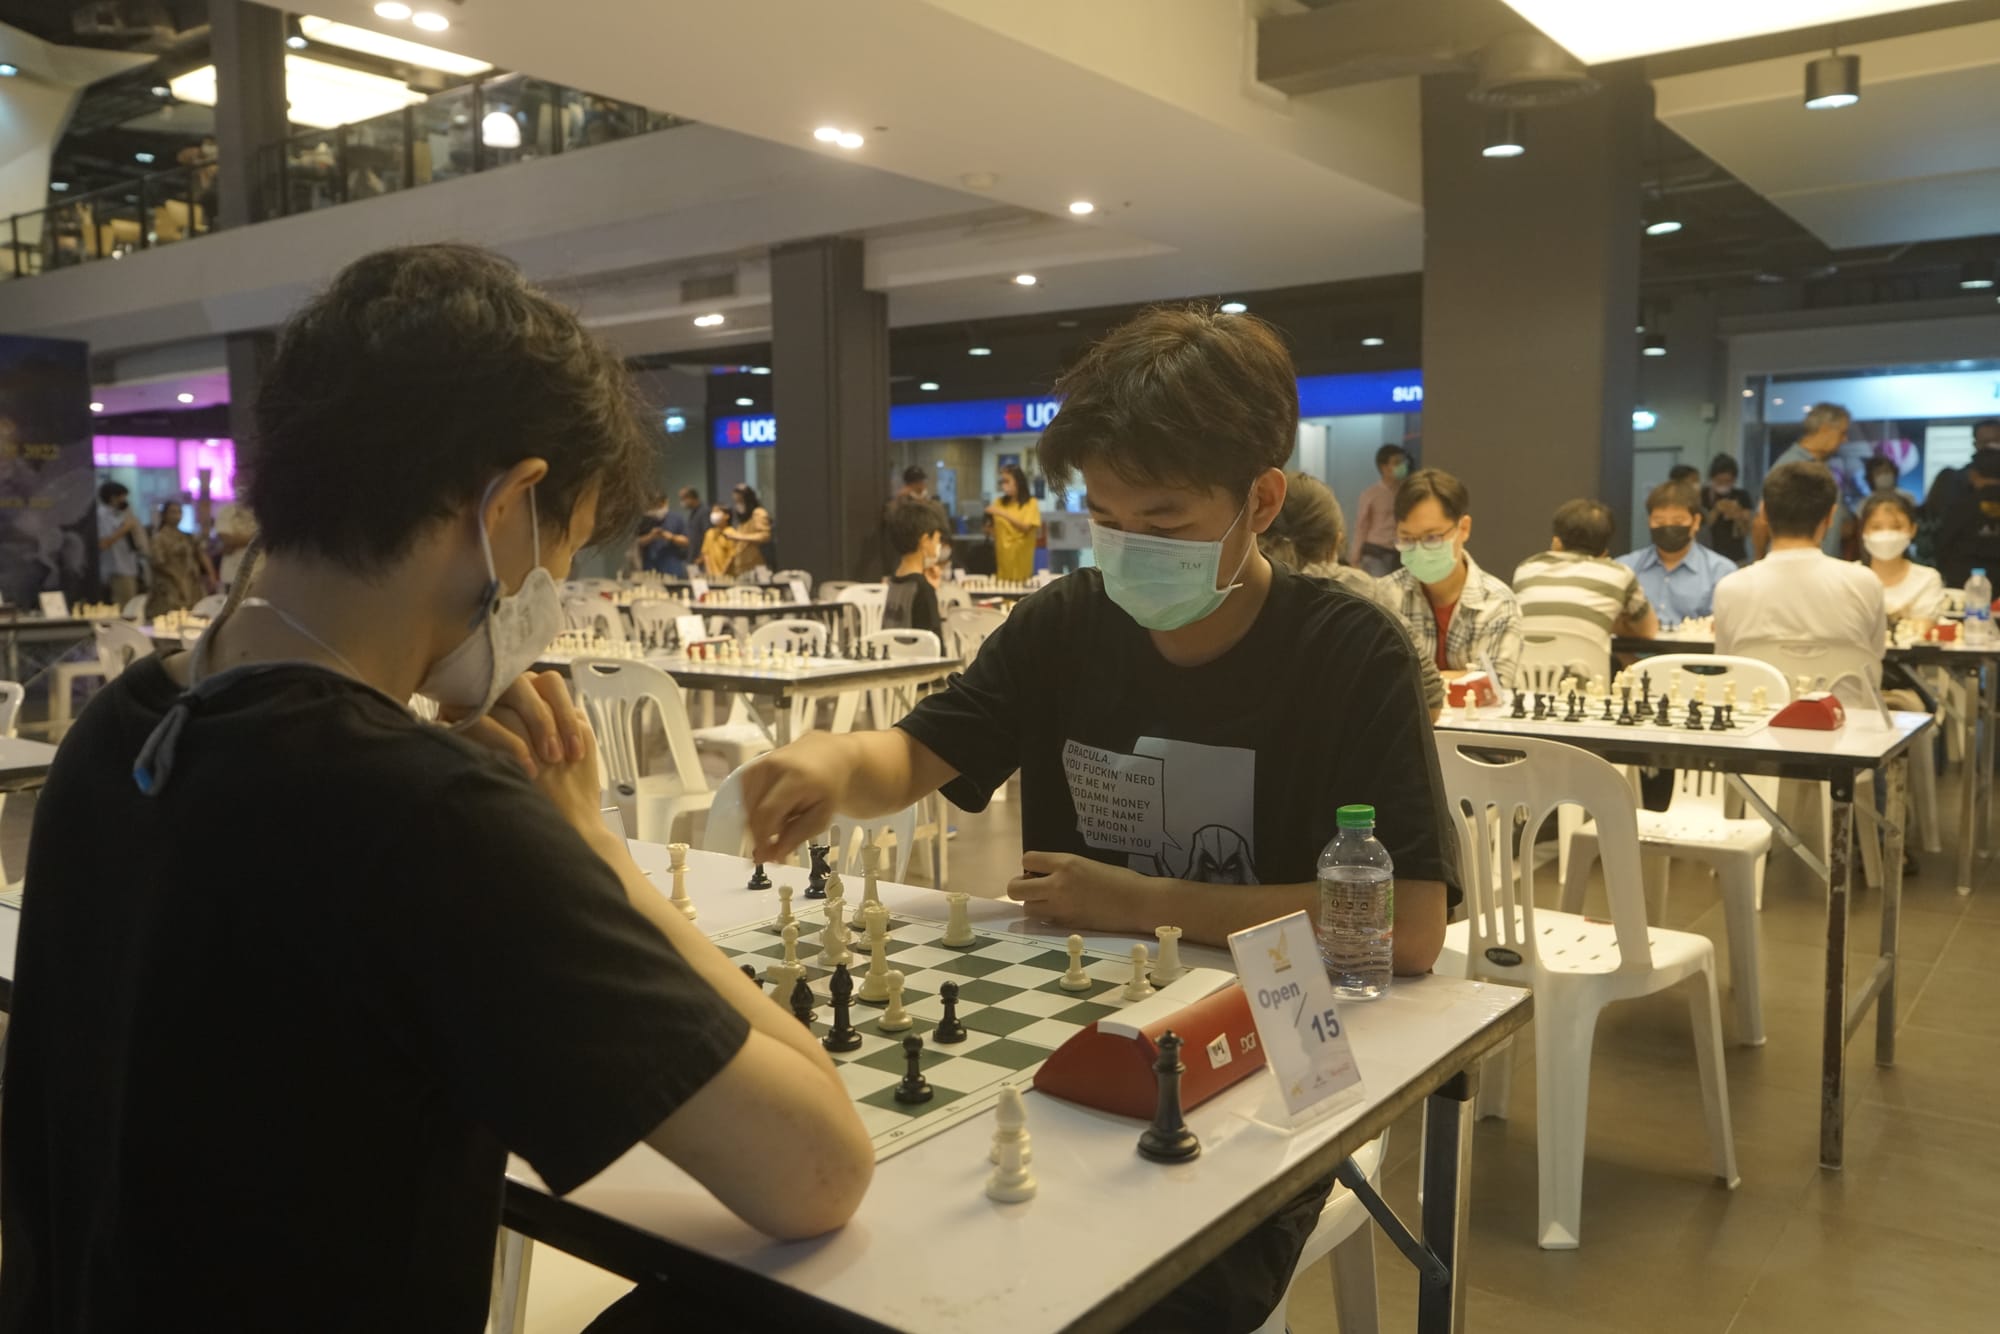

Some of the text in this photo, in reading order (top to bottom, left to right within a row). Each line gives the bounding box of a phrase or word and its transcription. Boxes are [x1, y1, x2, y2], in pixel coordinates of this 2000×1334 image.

[1026, 402, 1061, 428] UO
[1065, 757, 1081, 770] YOU
[1125, 773, 1156, 786] NERD
[1085, 777, 1100, 788] ME
[1102, 781, 1116, 792] MY
[1077, 802, 1145, 822] IN THE NAME
[1112, 797, 1151, 810] MONEY
[1080, 815, 1094, 827] HE
[1097, 819, 1128, 833] MOON
[1086, 830, 1152, 849] PUNISH YOU
[1258, 982, 1300, 1010] Open
[1311, 1009, 1340, 1042] 15
